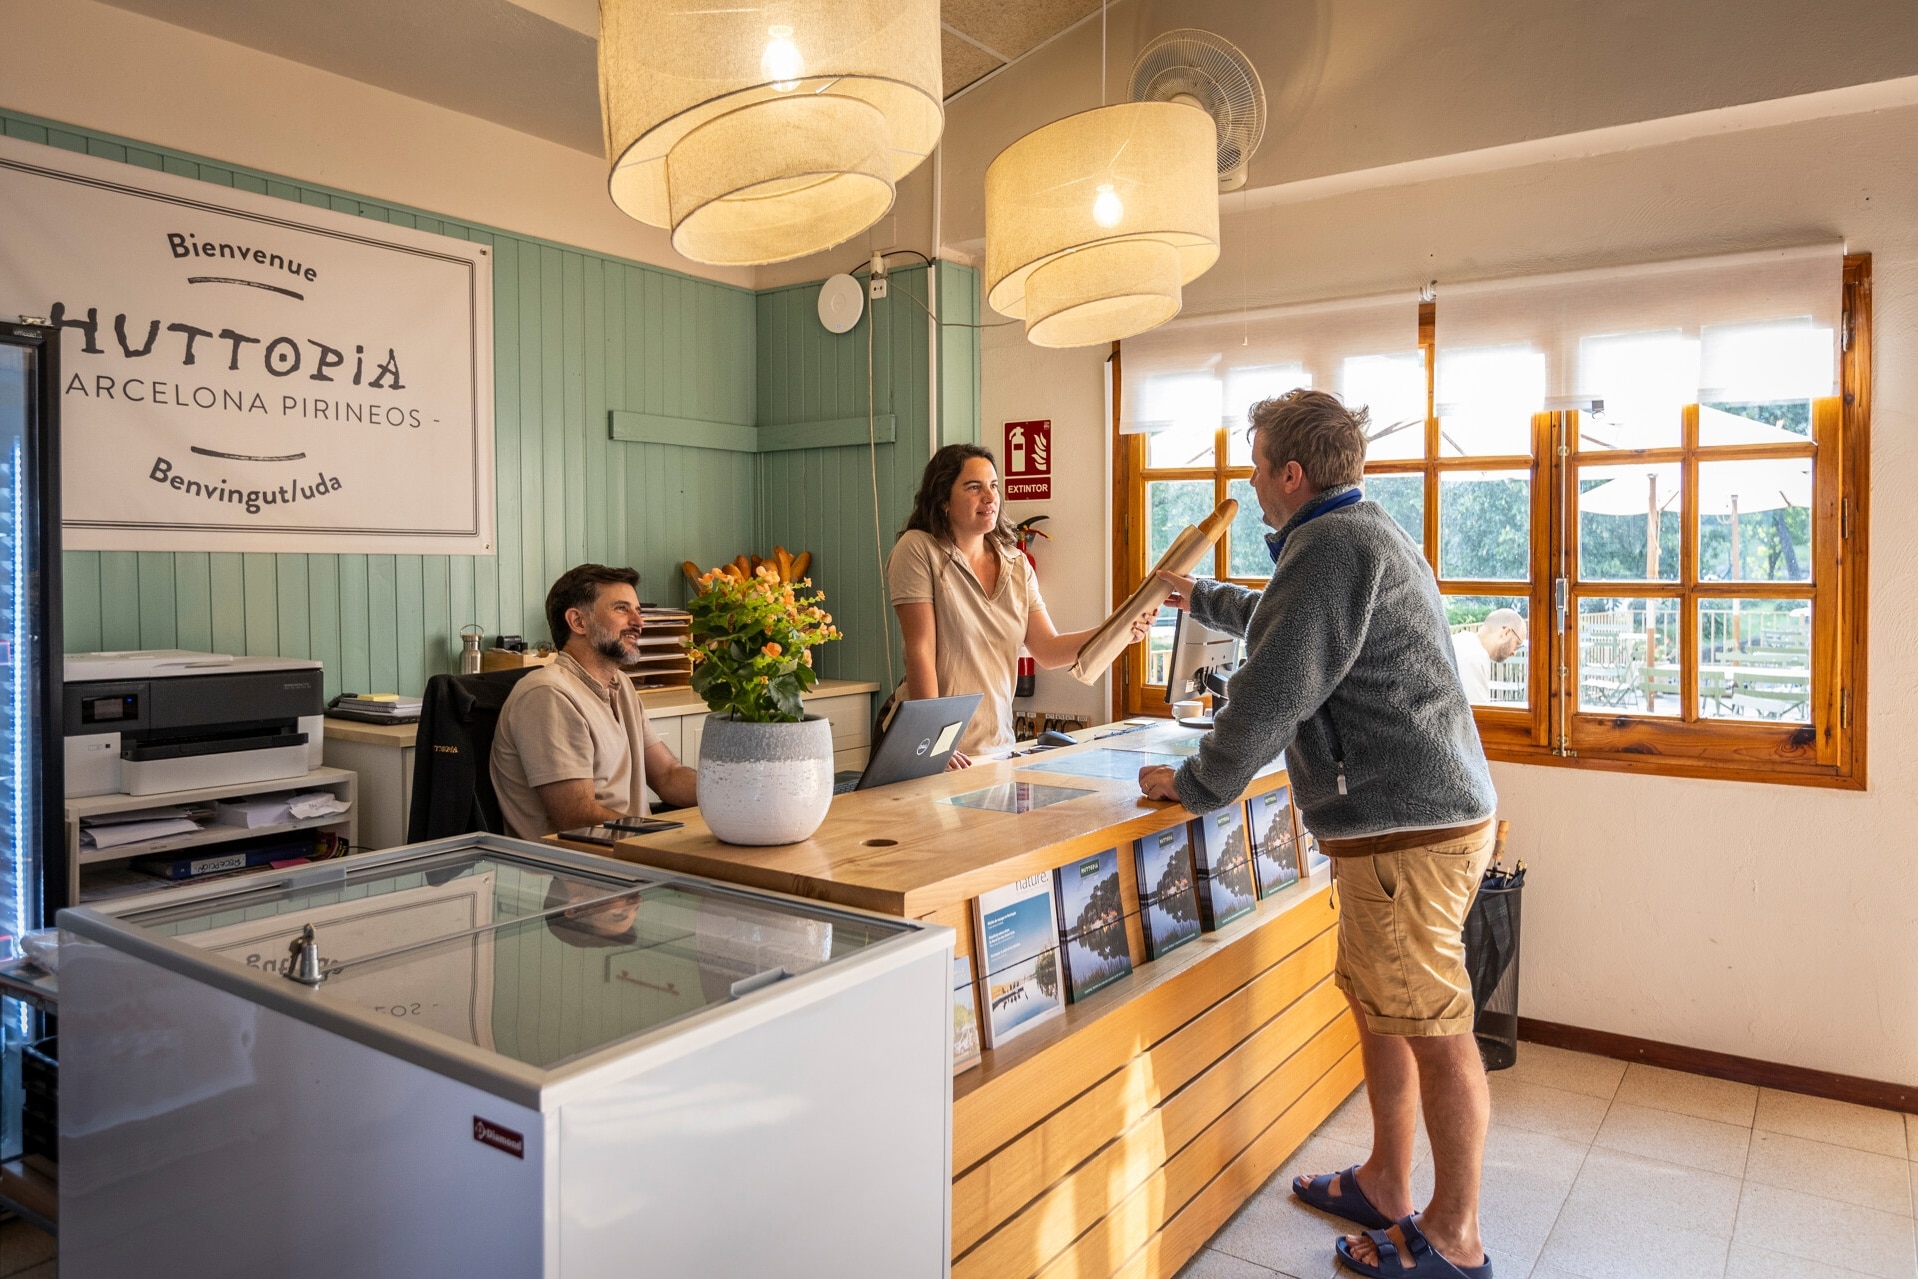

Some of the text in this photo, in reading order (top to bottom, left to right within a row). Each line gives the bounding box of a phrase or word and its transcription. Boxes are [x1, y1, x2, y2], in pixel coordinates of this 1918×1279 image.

[167, 232, 317, 282] Bienvenue
[65, 372, 268, 414] ARCELONA
[282, 395, 421, 428] PIRINEOS
[149, 456, 343, 514] Benvingut/uda
[1008, 484, 1048, 494] EXTINTOR
[486, 1127, 522, 1151] Diamond
